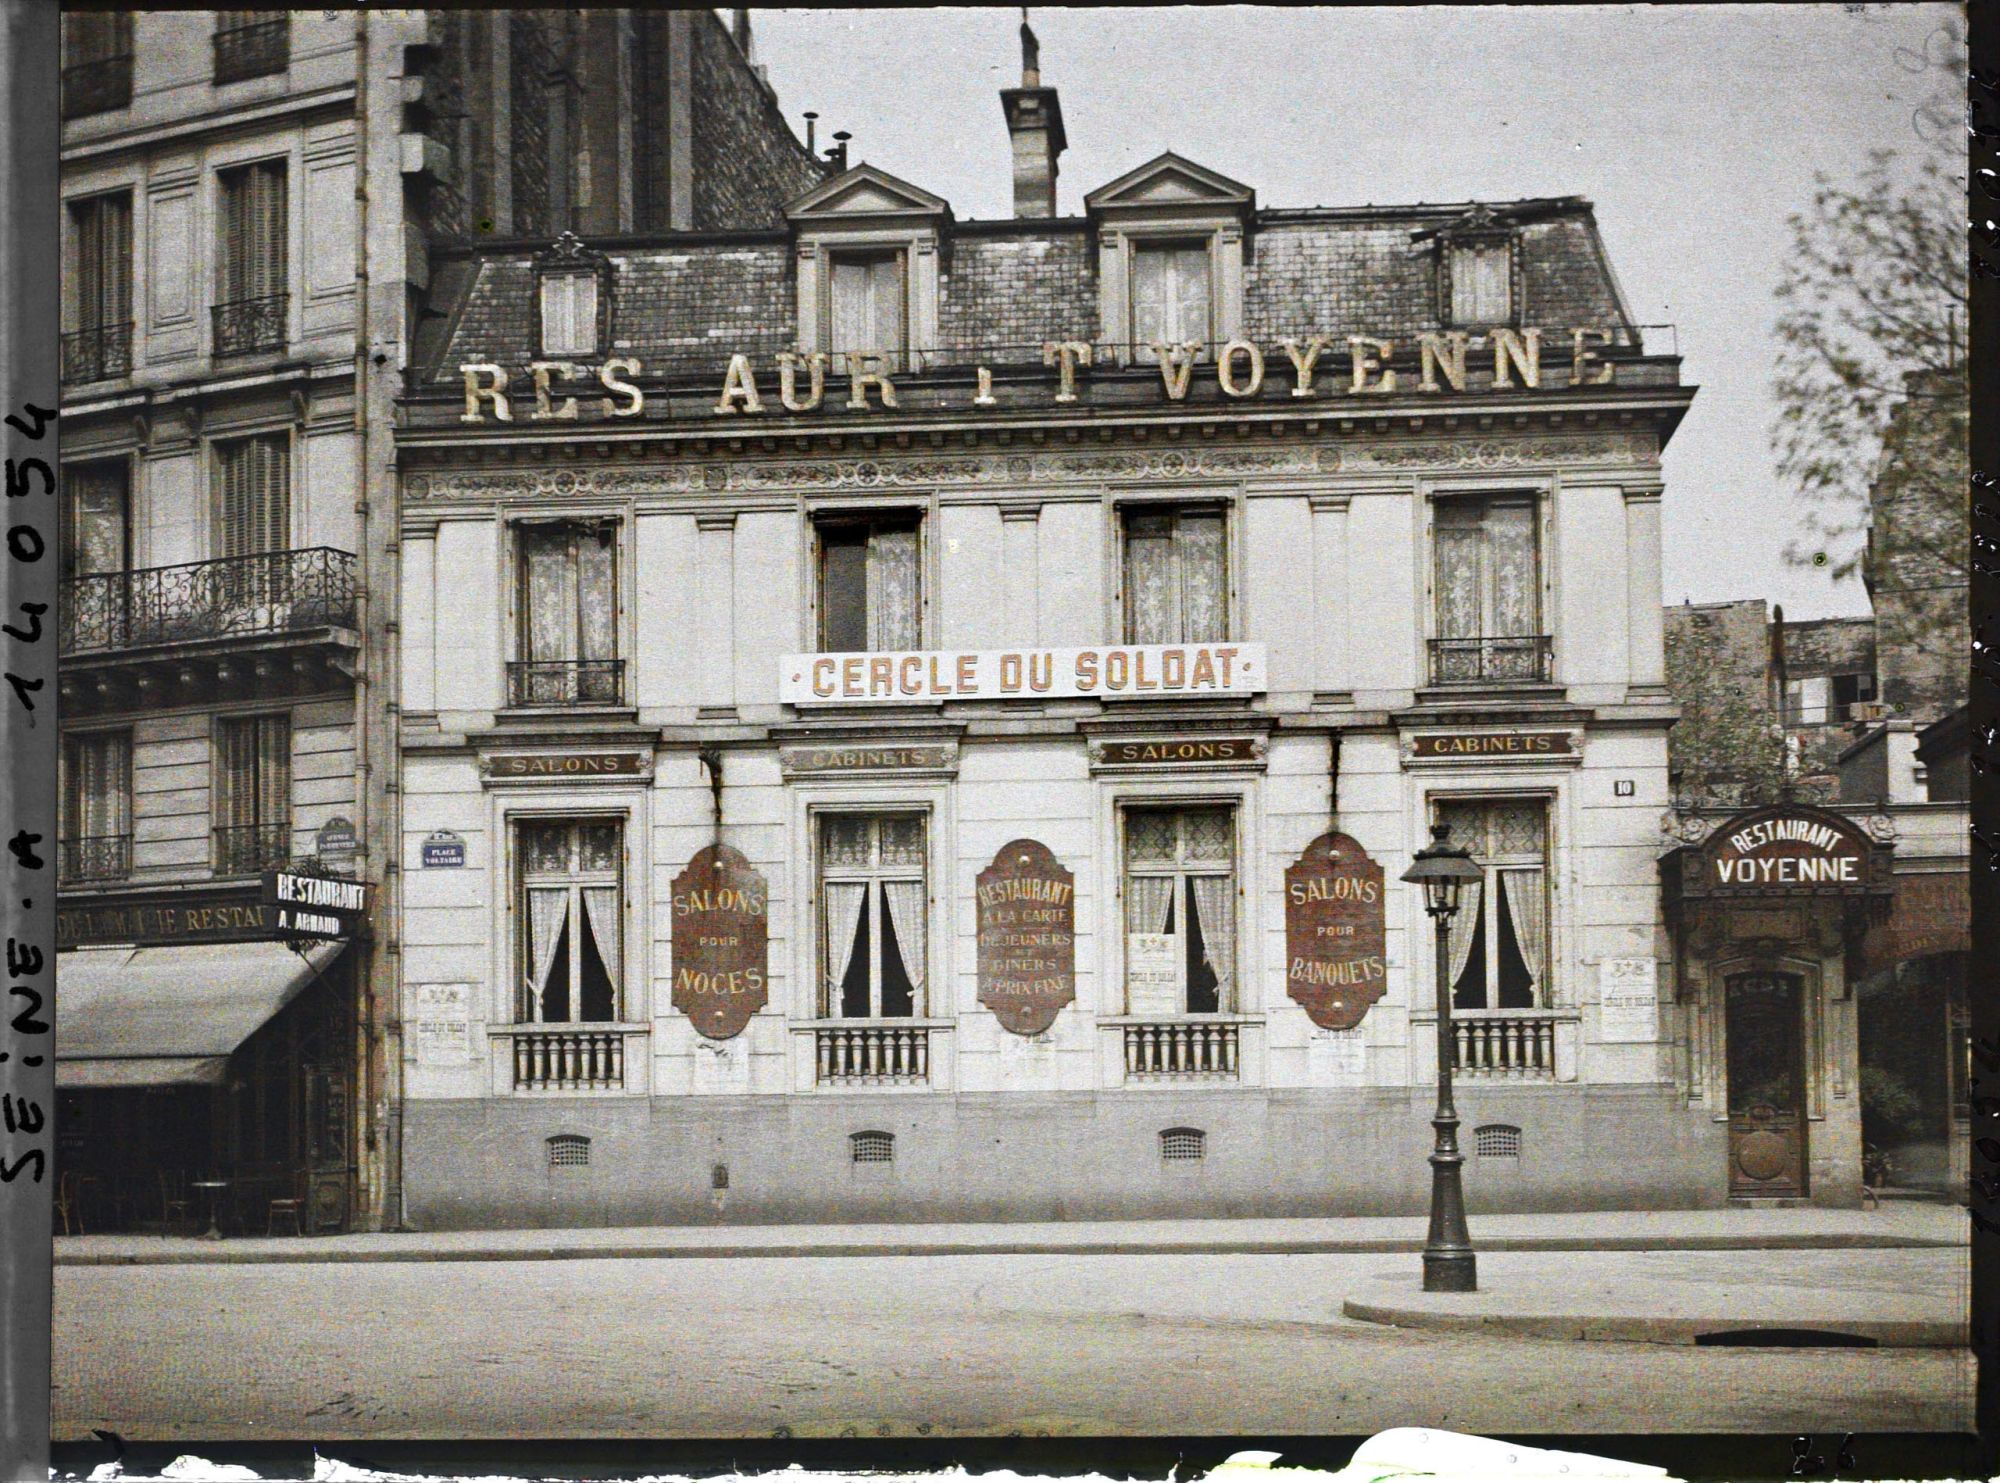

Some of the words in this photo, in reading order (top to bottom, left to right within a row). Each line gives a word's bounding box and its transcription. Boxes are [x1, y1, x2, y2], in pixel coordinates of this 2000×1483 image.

[1150, 328, 1613, 400] VOYENNE
[2, 403, 57, 712] 14054
[812, 655, 979, 696] CERCLE
[1000, 652, 1053, 692] DU
[1075, 648, 1239, 691] SOLDAT
[1122, 743, 1234, 760] SALONS
[1433, 736, 1552, 753] CABINETS
[510, 757, 619, 773] SALONS
[812, 751, 926, 767] CABINETS
[1617, 781, 1632, 795] 10
[1730, 819, 1844, 854] RESTAURANT
[1716, 857, 1859, 883] VOYENNE
[277, 873, 366, 911] RESTAURANT
[674, 888, 763, 916] SALONS
[978, 878, 1072, 907] RESTAURANT
[1290, 877, 1378, 905] SALONS
[1022, 908, 1068, 923] CARTE
[700, 936, 738, 946] POUR
[1317, 926, 1354, 937] POUR
[675, 967, 763, 994] NOCES
